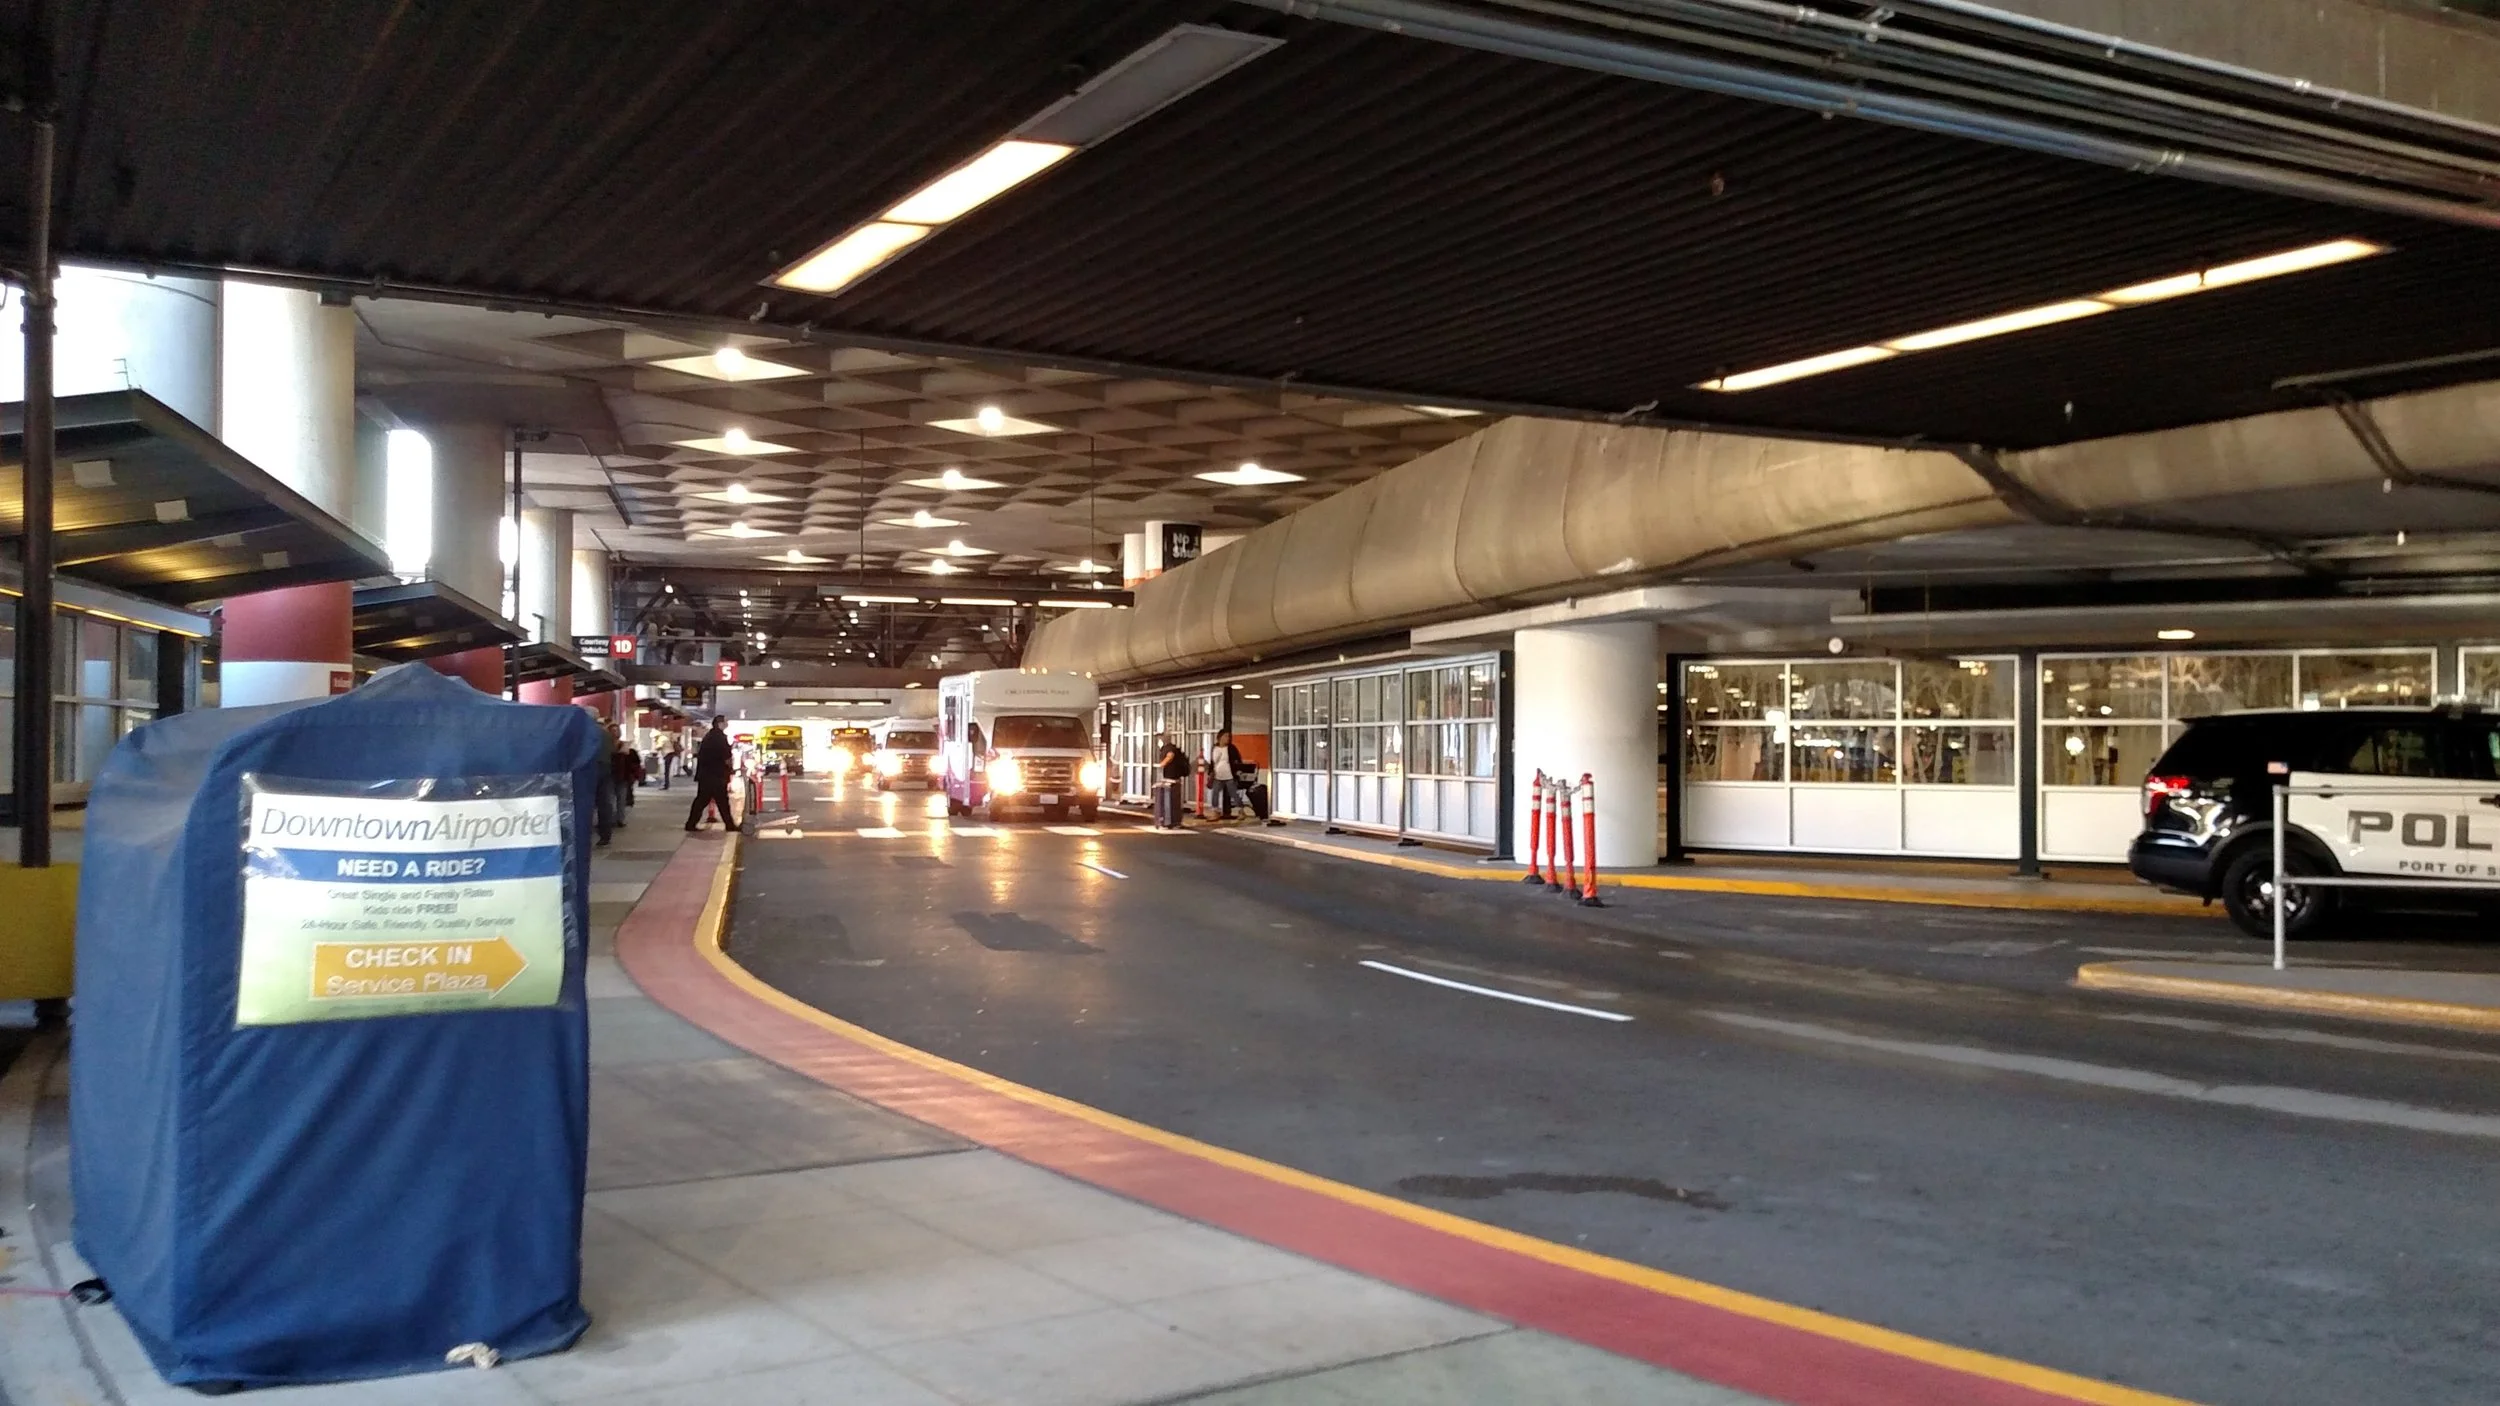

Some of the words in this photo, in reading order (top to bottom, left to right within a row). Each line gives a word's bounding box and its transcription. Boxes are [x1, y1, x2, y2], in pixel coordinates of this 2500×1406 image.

[614, 639, 632, 653] 1D
[721, 666, 732, 681] 5
[261, 808, 552, 848] DowntownAirporter
[2348, 810, 2492, 851] POL
[337, 858, 399, 878] NEED
[402, 860, 421, 878] A
[425, 858, 486, 878] RIDE?
[2399, 861, 2447, 874] PORT
[2455, 864, 2477, 874] OF
[400, 891, 421, 900] and
[424, 889, 460, 901] Family
[345, 946, 440, 969] CHECK
[446, 945, 473, 965] IN
[326, 974, 417, 996] Service
[423, 972, 488, 992] Plaza
